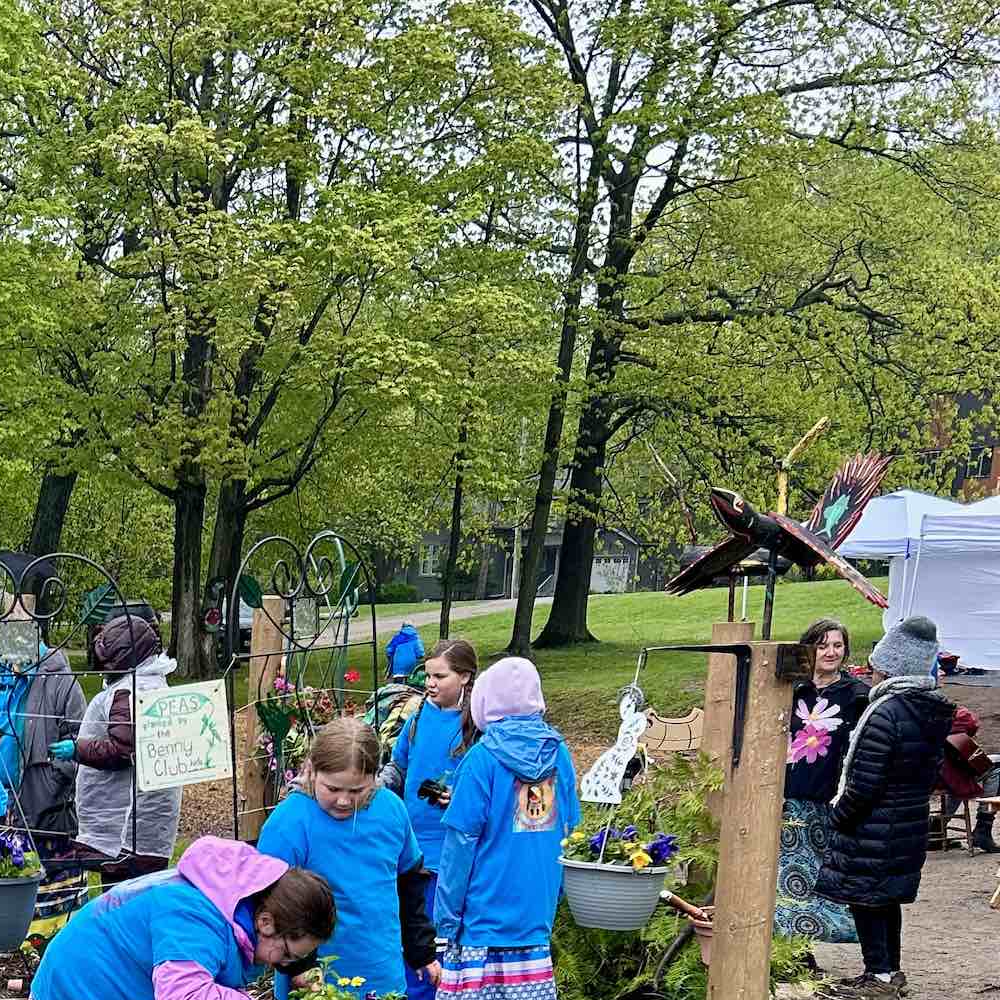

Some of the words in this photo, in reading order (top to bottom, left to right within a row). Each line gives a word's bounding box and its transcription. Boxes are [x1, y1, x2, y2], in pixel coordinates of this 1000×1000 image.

[159, 696, 199, 717] PEAS
[147, 739, 192, 758] Benny
[154, 756, 187, 777] Club
